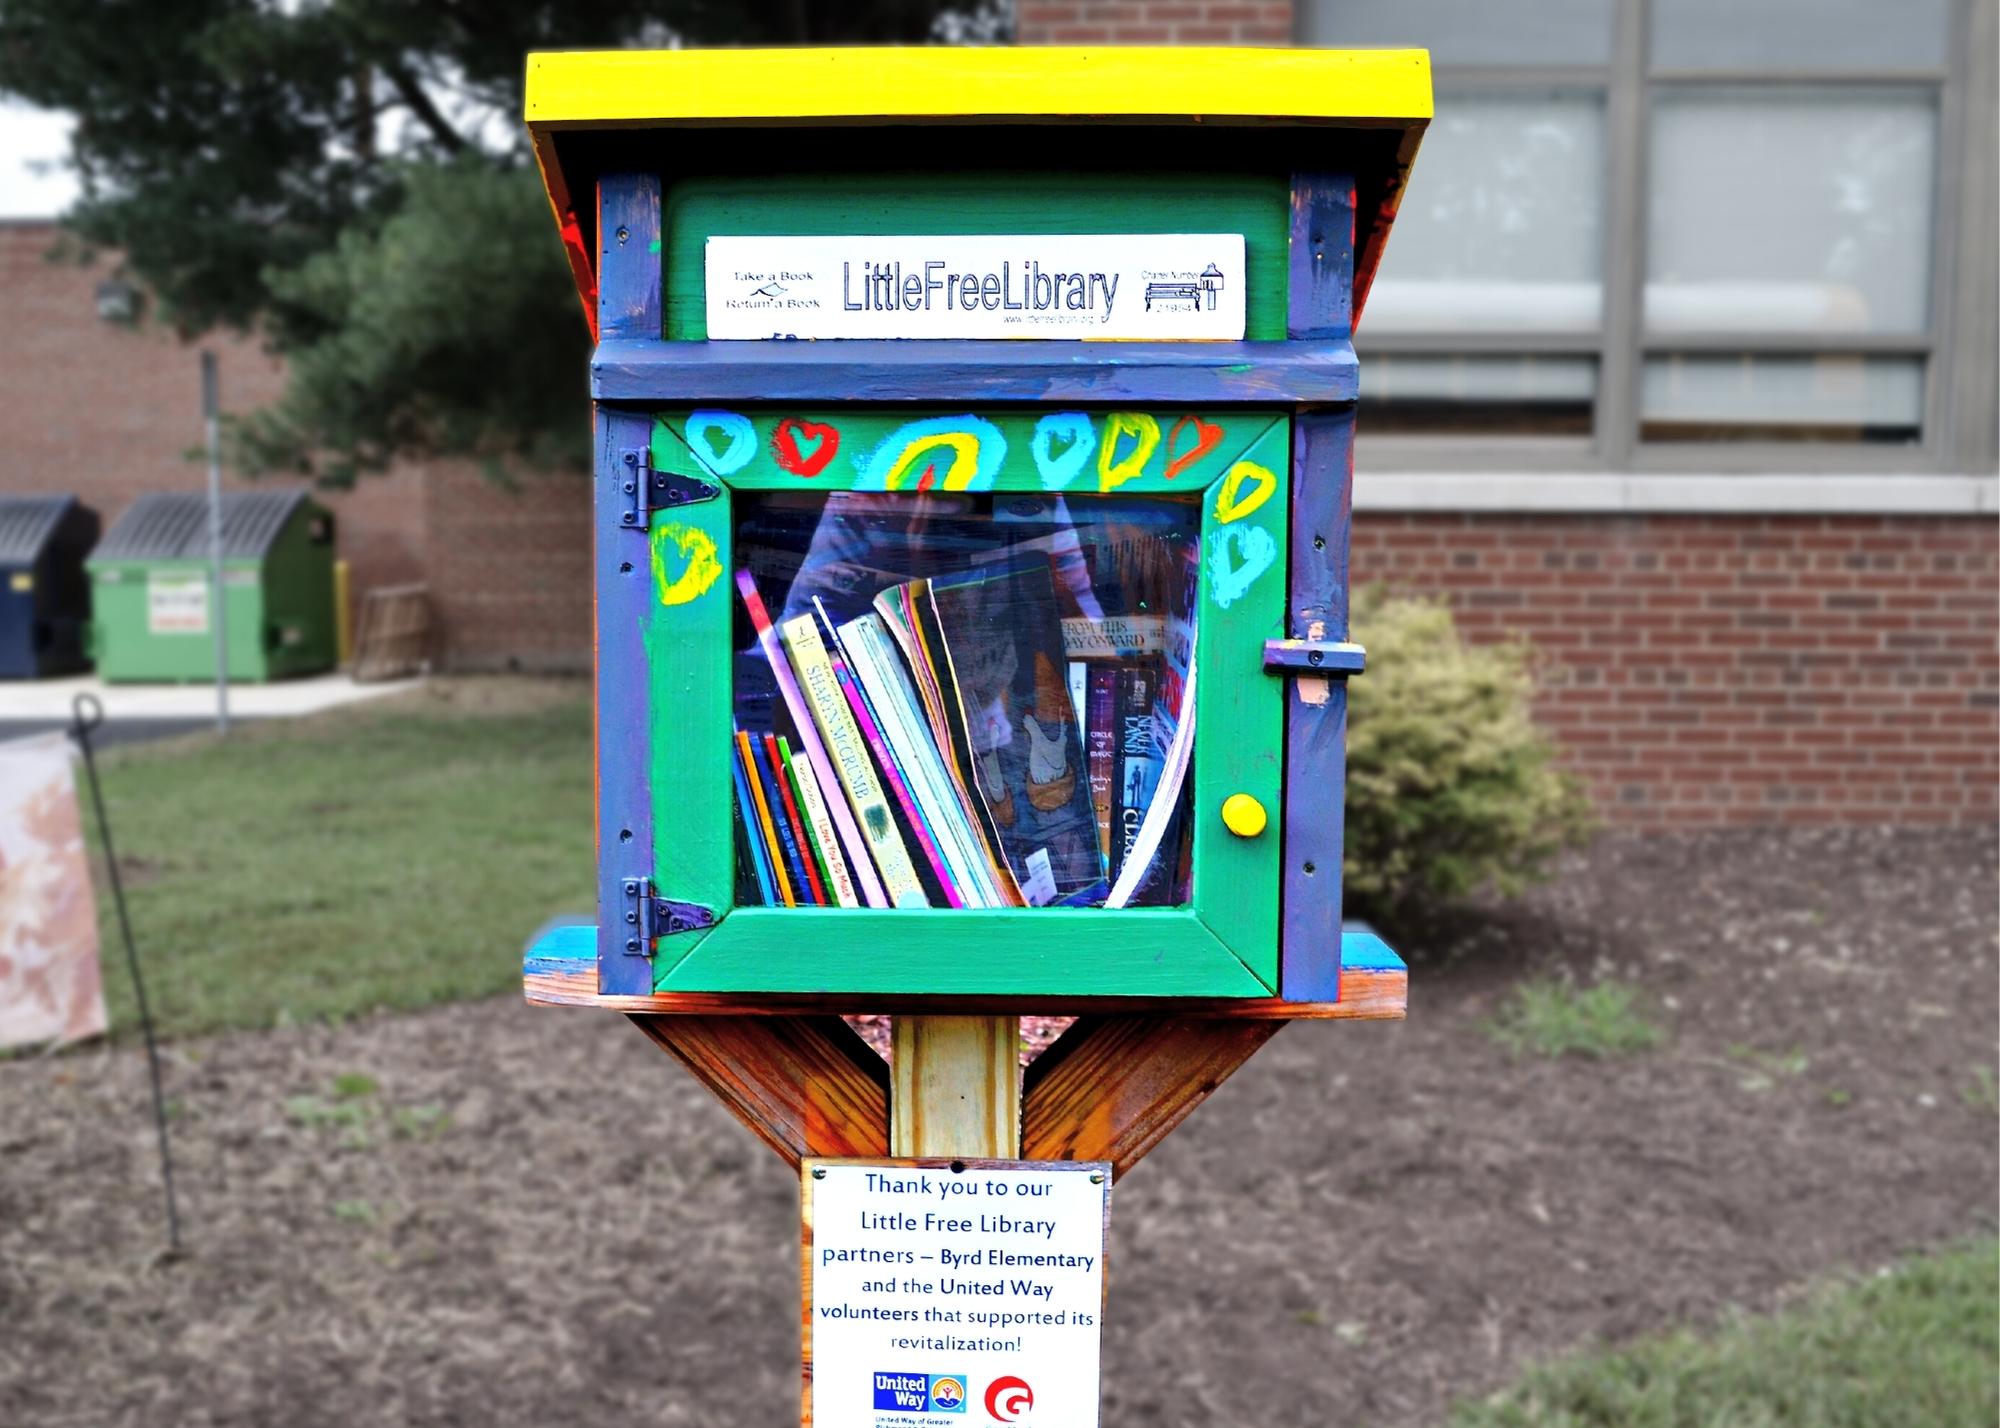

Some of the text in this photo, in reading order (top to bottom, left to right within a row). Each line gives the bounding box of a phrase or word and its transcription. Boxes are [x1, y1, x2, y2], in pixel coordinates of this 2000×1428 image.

[734, 272, 764, 281] Take
[780, 272, 814, 281] Book
[725, 299, 770, 308] Return
[787, 299, 820, 308] Book
[843, 260, 1120, 324] LittleFreeLibrary
[1087, 634, 1145, 648] ONWARD
[805, 664, 841, 732] SHARYN
[1124, 716, 1140, 754] LAND
[817, 822, 833, 843] Love
[825, 844, 839, 861] You
[835, 874, 853, 899] Much
[865, 1174, 1053, 1200] Thank you to our
[862, 1211, 1056, 1239] Little Free Library
[823, 1248, 914, 1266] partners
[941, 1249, 982, 1269] Byrd
[989, 1250, 1094, 1272] Elementary
[862, 1278, 1053, 1301] and the United Way
[821, 1303, 1094, 1328] volunteers that supported its
[891, 1335, 1021, 1351] revitalization!
[875, 1376, 926, 1392] United
[895, 1392, 926, 1411] Way
[875, 1416, 899, 1424] United
[901, 1417, 916, 1426] Way
[918, 1417, 925, 1425] of
[927, 1418, 953, 1427] Greater
